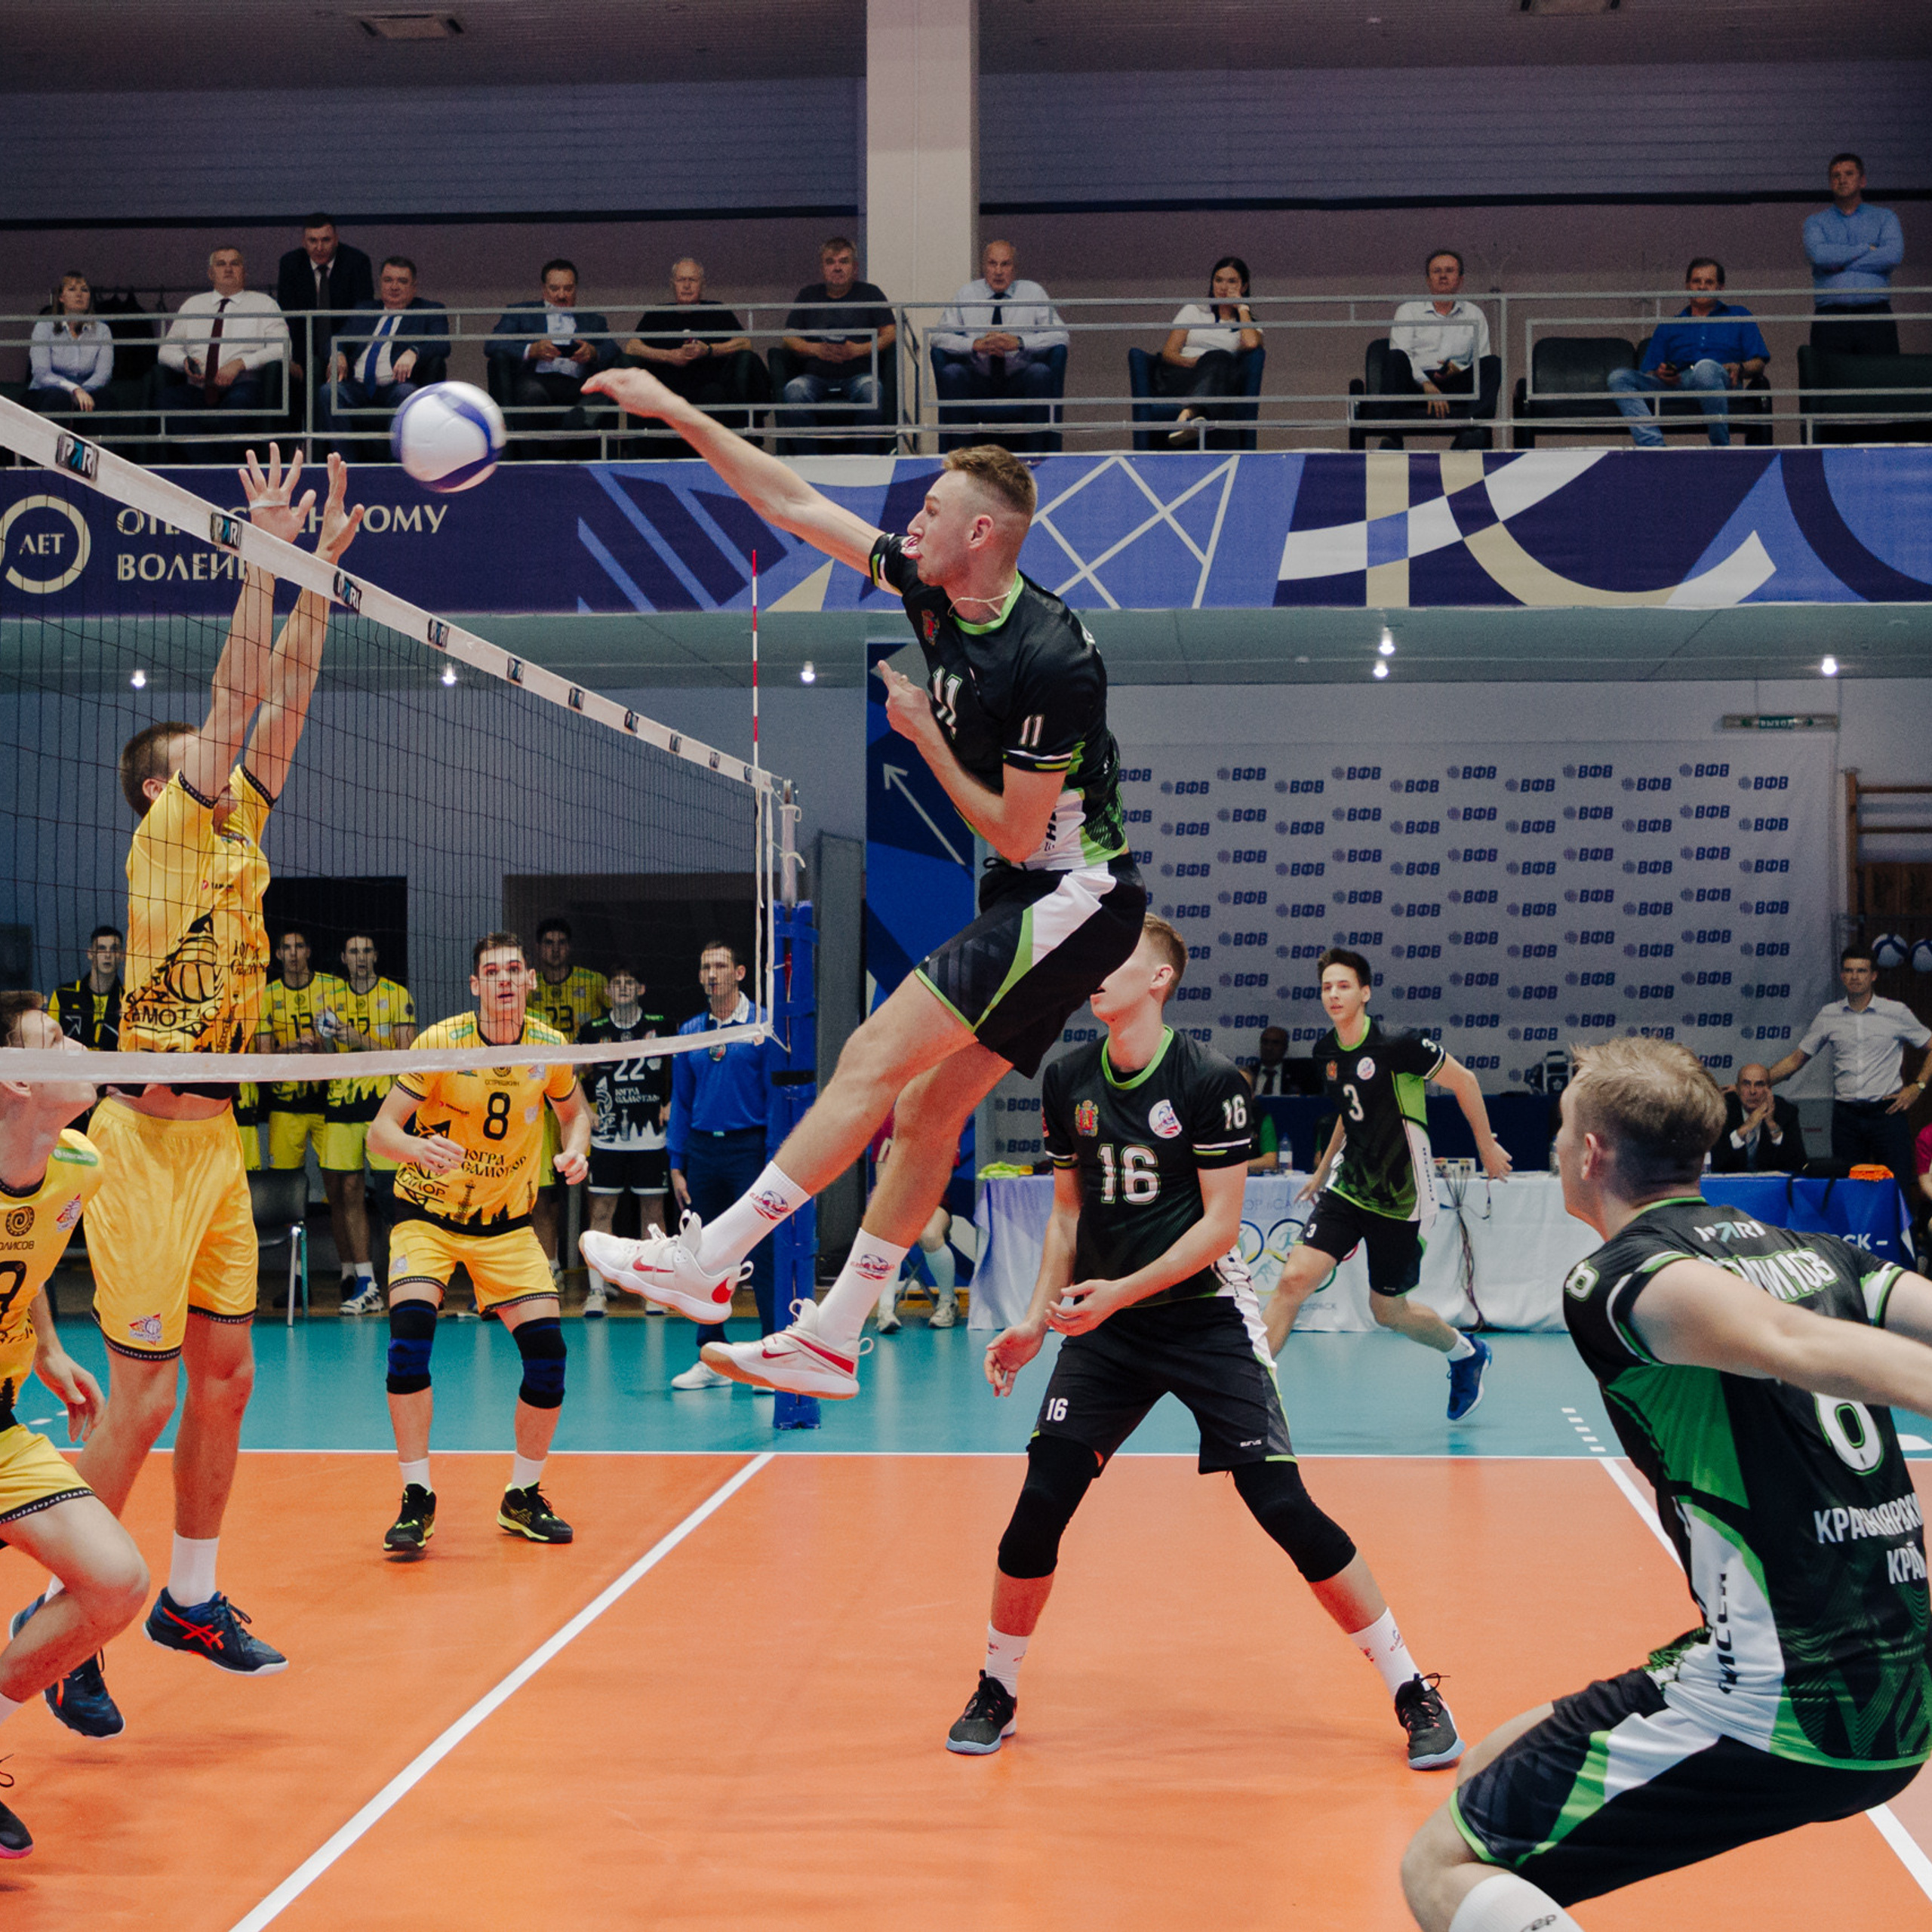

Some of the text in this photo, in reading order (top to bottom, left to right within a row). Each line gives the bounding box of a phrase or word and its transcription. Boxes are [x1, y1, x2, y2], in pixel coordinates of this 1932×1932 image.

[19, 533, 65, 555] ЛЕТ
[1020, 714, 1046, 747] 11
[1232, 768, 1266, 781] ВФВ
[1347, 767, 1381, 780] ВФВ
[1463, 766, 1497, 780] ВФВ
[1579, 764, 1613, 778] ВФВ
[1695, 764, 1729, 777] ВФВ
[1176, 781, 1210, 795] ВФВ
[1291, 780, 1324, 794] ВФВ
[1405, 780, 1439, 793] ВФВ
[1521, 779, 1555, 792] ВФВ
[1638, 777, 1672, 791] ВФВ
[1755, 777, 1789, 790] ВФВ
[1232, 809, 1266, 823] ВФВ
[1348, 808, 1382, 822] ВФВ
[1463, 808, 1497, 821] ВФВ
[1579, 807, 1613, 820] ВФВ
[1696, 805, 1730, 819] ВФВ
[1176, 823, 1210, 836] ВФВ
[1291, 822, 1324, 835] ВФВ
[1406, 821, 1440, 835] ВФВ
[1521, 820, 1555, 834] ВФВ
[1638, 819, 1672, 832] ВФВ
[1755, 818, 1789, 832] ВФВ
[1131, 851, 1153, 864] ФВ
[1233, 850, 1267, 863] ВФВ
[1348, 849, 1382, 863] ВФВ
[1463, 849, 1497, 863] ВФВ
[1580, 848, 1614, 861] ВФВ
[1697, 847, 1730, 860] ВФВ
[1177, 863, 1211, 877] ВФВ
[1291, 863, 1325, 876] ВФВ
[1406, 862, 1440, 875] ВФВ
[1522, 862, 1556, 875] ВФВ
[1638, 861, 1672, 875] ВФВ
[1755, 860, 1789, 873] ВФВ
[1233, 891, 1267, 905] ВФВ
[1349, 891, 1383, 904] ВФВ
[1464, 890, 1498, 903] ВФВ
[1580, 889, 1614, 903] ВФВ
[1697, 888, 1730, 902] ВФВ
[1177, 905, 1211, 918] ВФВ
[1291, 904, 1325, 918] ВФВ
[1407, 903, 1441, 917] ВФВ
[1522, 903, 1556, 917] ВФВ
[1639, 902, 1673, 915] ВФВ
[1755, 901, 1789, 915] ВФВ
[1234, 933, 1268, 946] ВФВ
[1349, 932, 1383, 946] ВФВ
[1464, 931, 1498, 945] ВФВ
[1580, 931, 1614, 945] ВФВ
[1697, 930, 1731, 943] ВФВ
[1188, 946, 1211, 959] ФВ
[1407, 945, 1441, 958] ВФВ
[1523, 945, 1557, 958] ВФВ
[1639, 944, 1673, 958] ВФВ
[1756, 943, 1790, 956] ВФВ
[1235, 974, 1269, 987] ВФВ
[1465, 973, 1499, 986] ВФВ
[1581, 973, 1615, 986] ВФВ
[1697, 972, 1731, 986] ВФВ
[1177, 987, 1211, 1001] ВФВ
[1407, 986, 1441, 1000] ВФВ
[1524, 986, 1558, 999] ВФВ
[1640, 986, 1674, 999] ВФВ
[1756, 984, 1790, 998] ВФВ
[1235, 1014, 1269, 1028] ВФВ
[1466, 1014, 1500, 1027] ВФВ
[1582, 1014, 1616, 1027] ВФВ
[1698, 1013, 1732, 1026] ВФВ
[1524, 1028, 1558, 1041] ВФВ
[1757, 1026, 1791, 1039] ВФВ
[1466, 1056, 1500, 1069] ВФВ
[1007, 1098, 1041, 1112] ВФВ
[1343, 1084, 1364, 1122] 3
[483, 1091, 511, 1141] 8
[1222, 1094, 1247, 1131] 16
[1008, 1140, 1041, 1153] ВФВ
[461, 1155, 527, 1179] САМОТОР
[1097, 1143, 1161, 1205] 16
[1306, 1223, 1318, 1238] 3
[1046, 1398, 1069, 1422] 16
